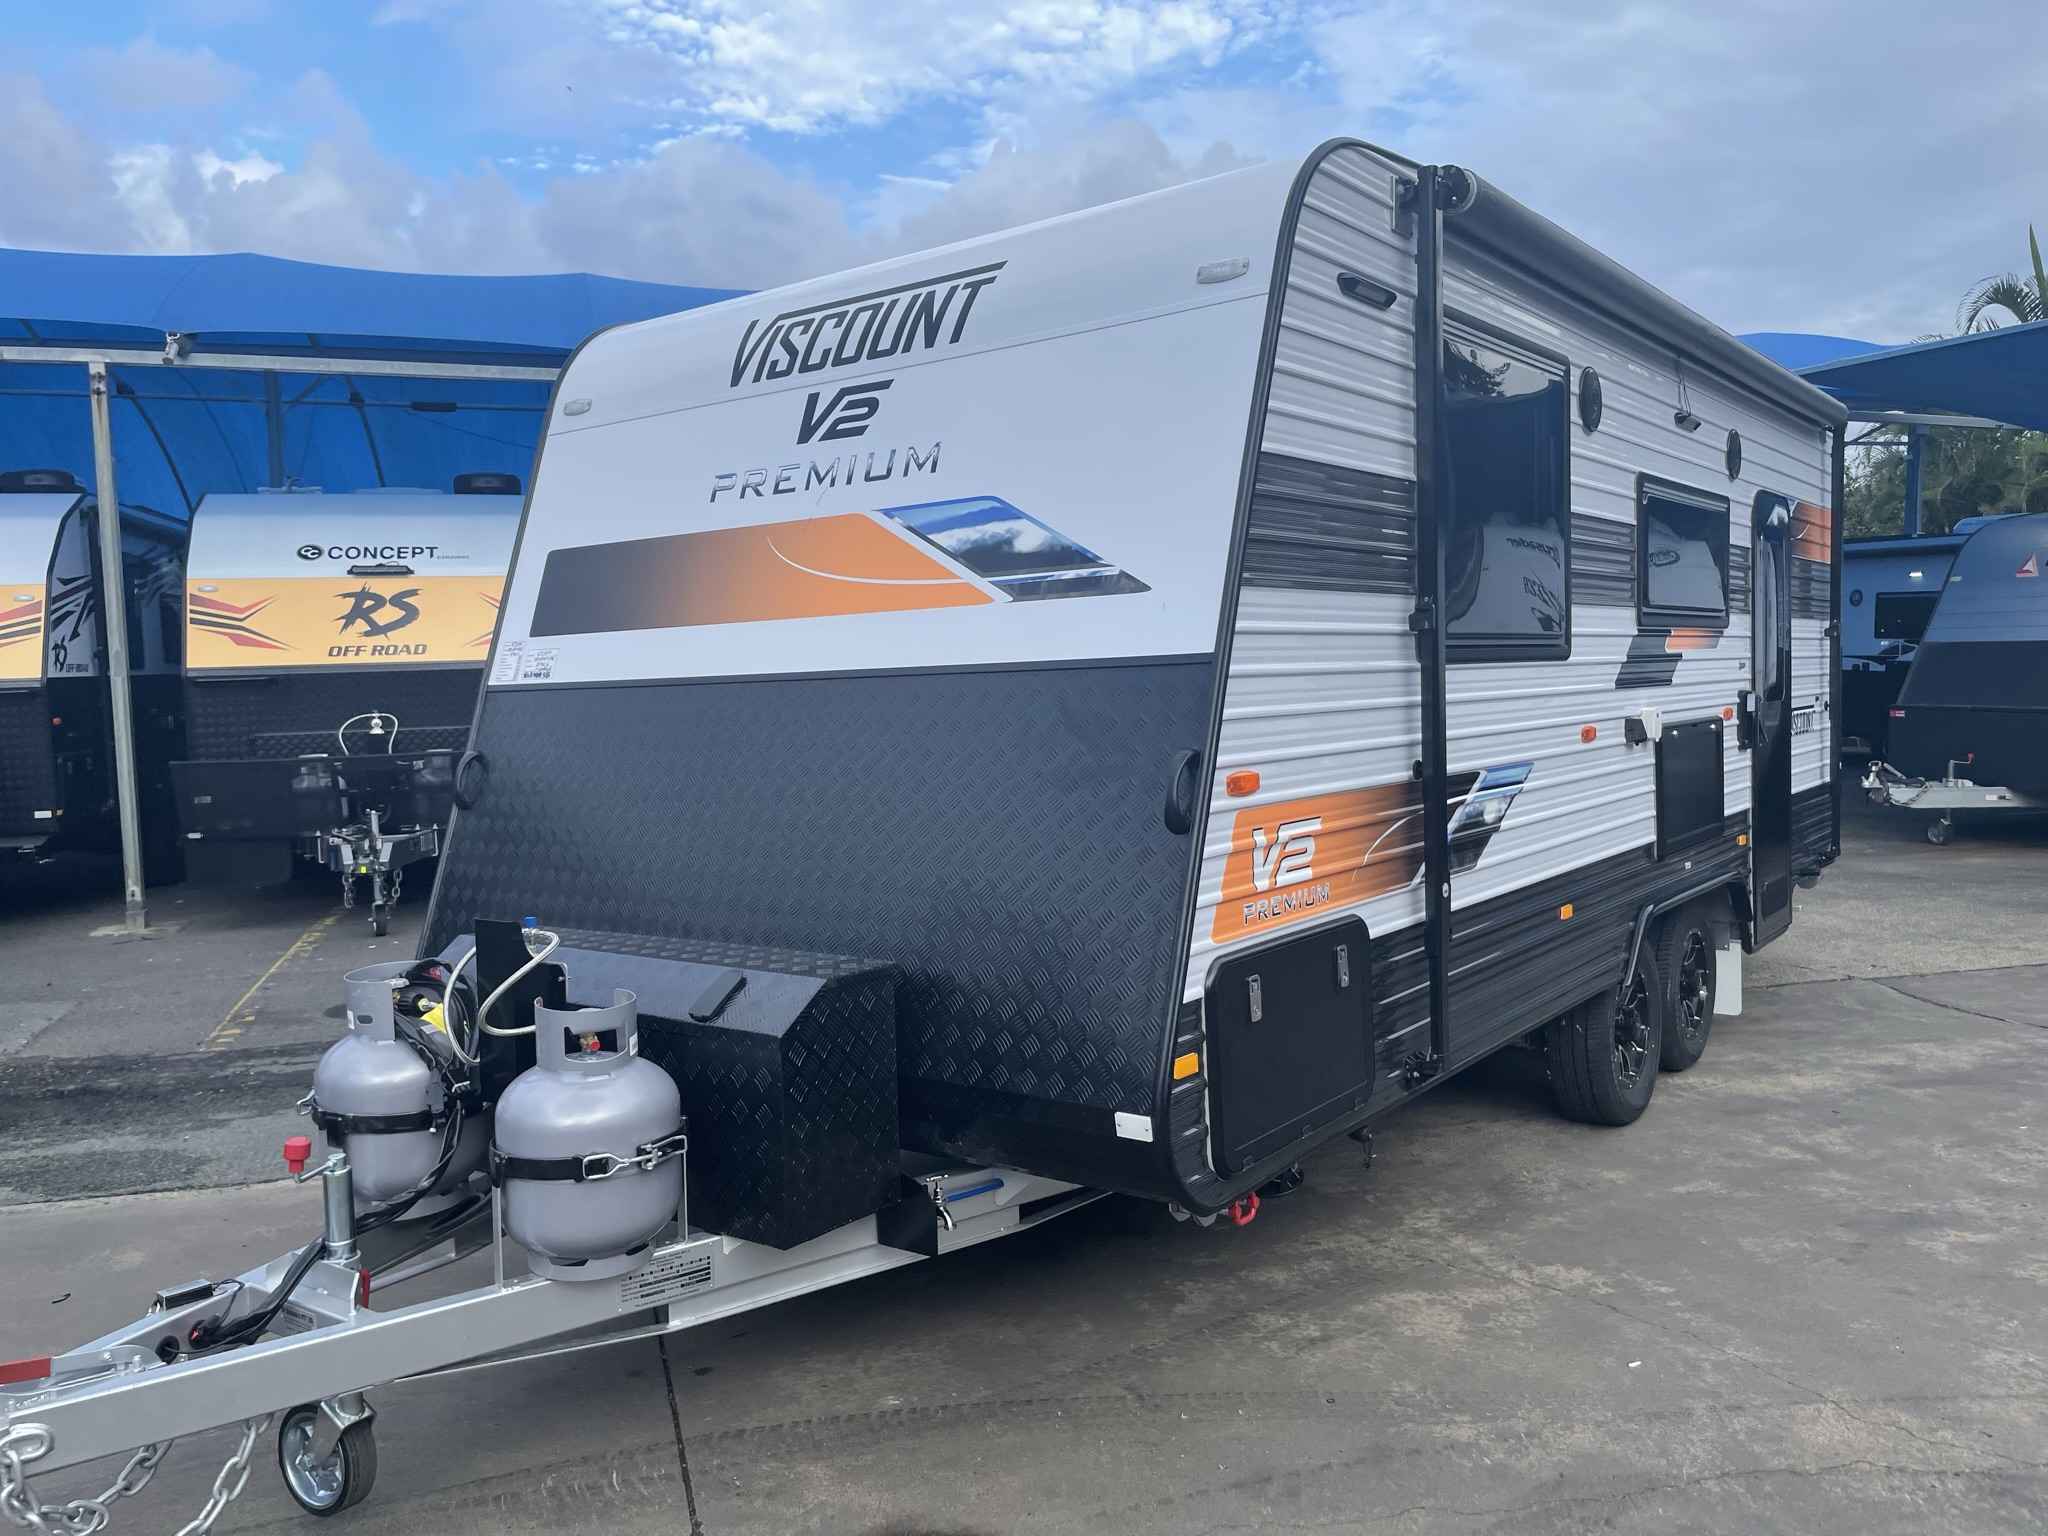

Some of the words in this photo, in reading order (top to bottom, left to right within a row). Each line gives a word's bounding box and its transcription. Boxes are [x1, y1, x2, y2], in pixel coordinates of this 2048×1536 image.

[730, 260, 1009, 388] VISCOUNT
[796, 378, 895, 445] V2
[709, 441, 942, 503] PREMIUM
[328, 546, 438, 560] CONCEPT
[332, 581, 424, 640] RS
[328, 645, 367, 657] OFF
[371, 643, 428, 656] ROAD
[1251, 815, 1322, 892] V2
[1243, 882, 1330, 925] PREMIUM
